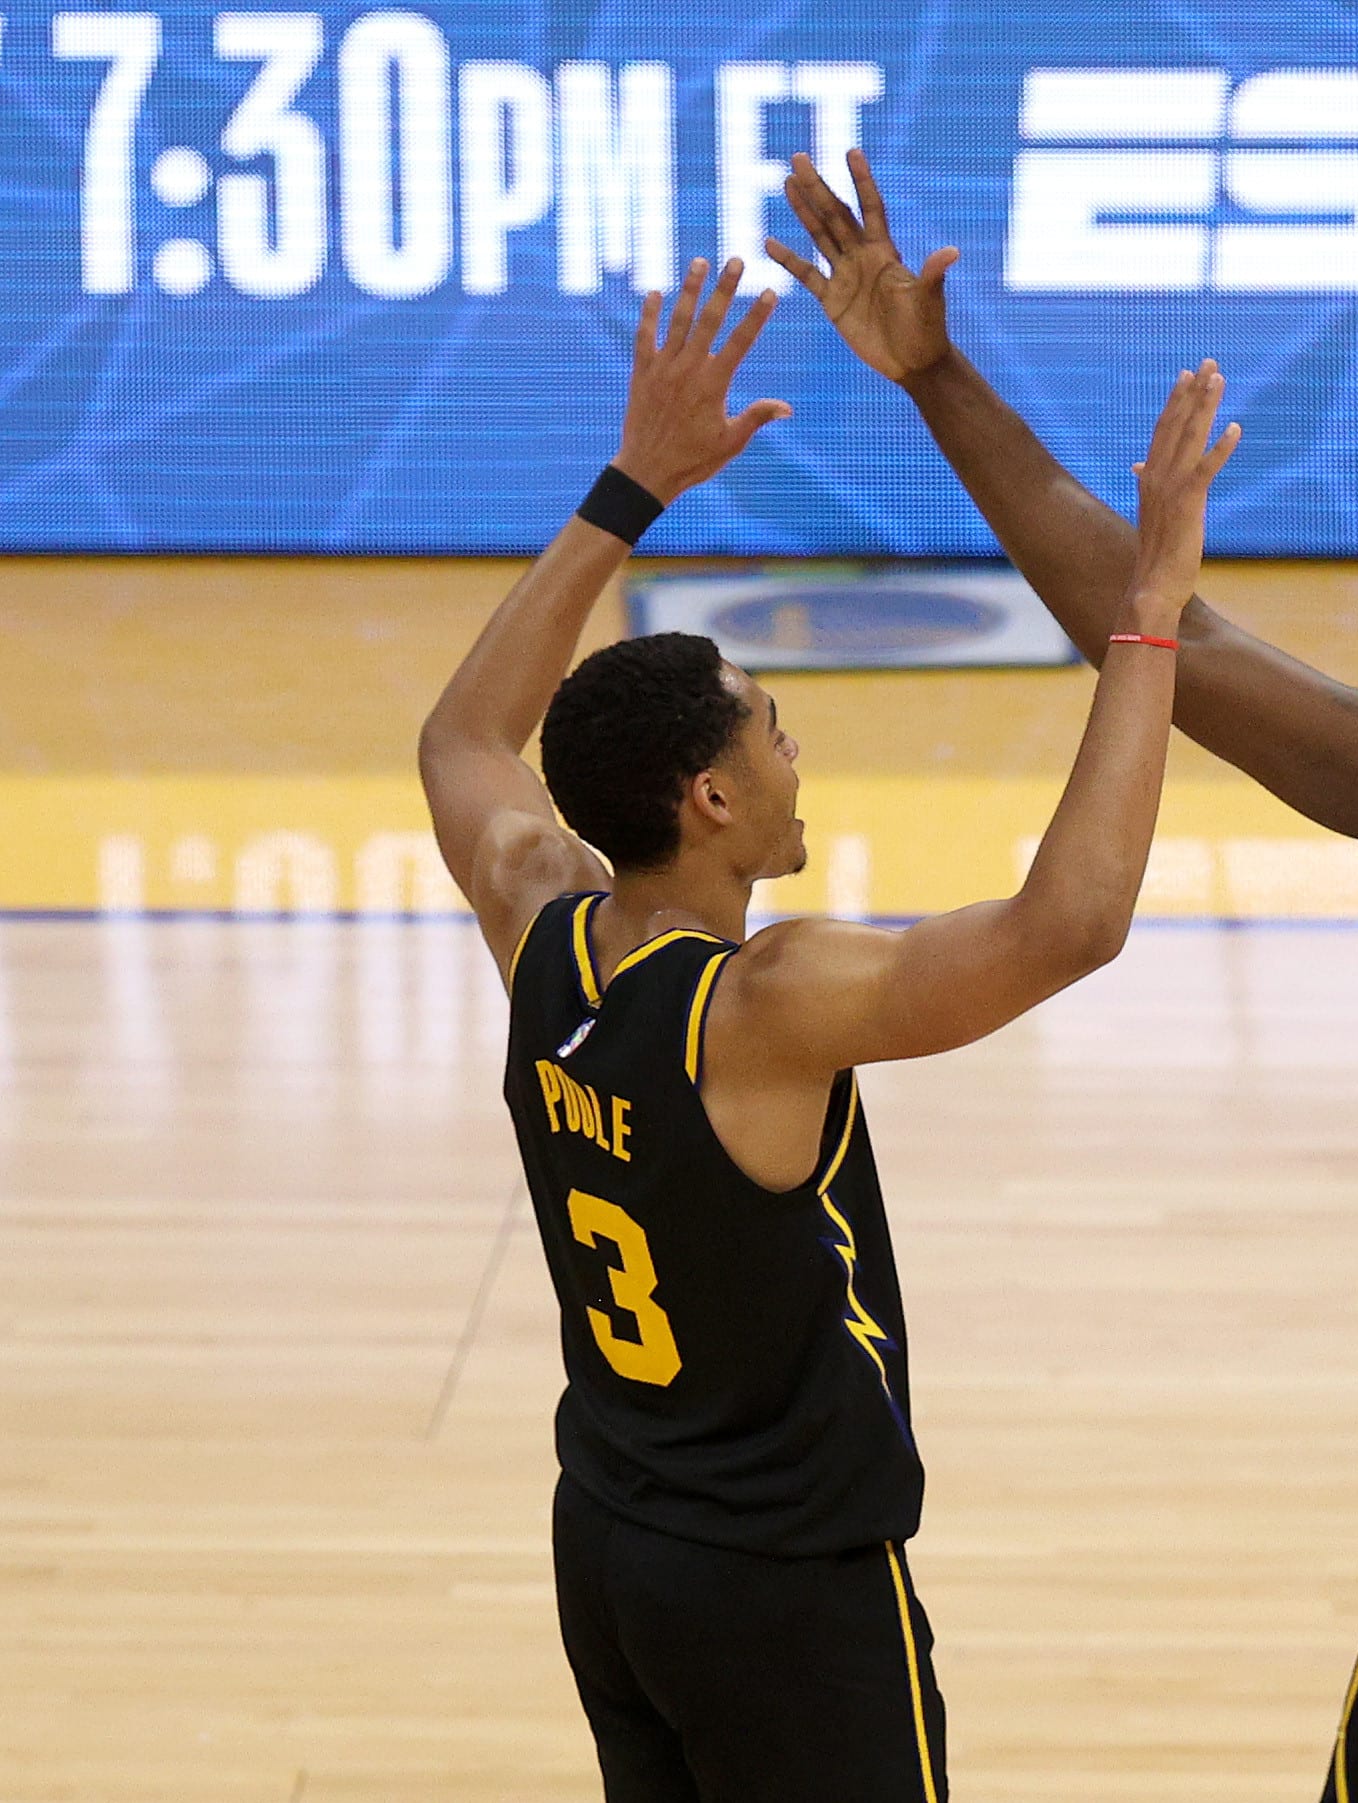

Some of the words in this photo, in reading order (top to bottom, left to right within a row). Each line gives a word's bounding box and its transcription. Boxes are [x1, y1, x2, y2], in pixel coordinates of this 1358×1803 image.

[52, 11, 676, 299] 7:30PM
[715, 61, 886, 296] ET
[535, 1059, 631, 1162] POOLE
[567, 1188, 682, 1386] 3
